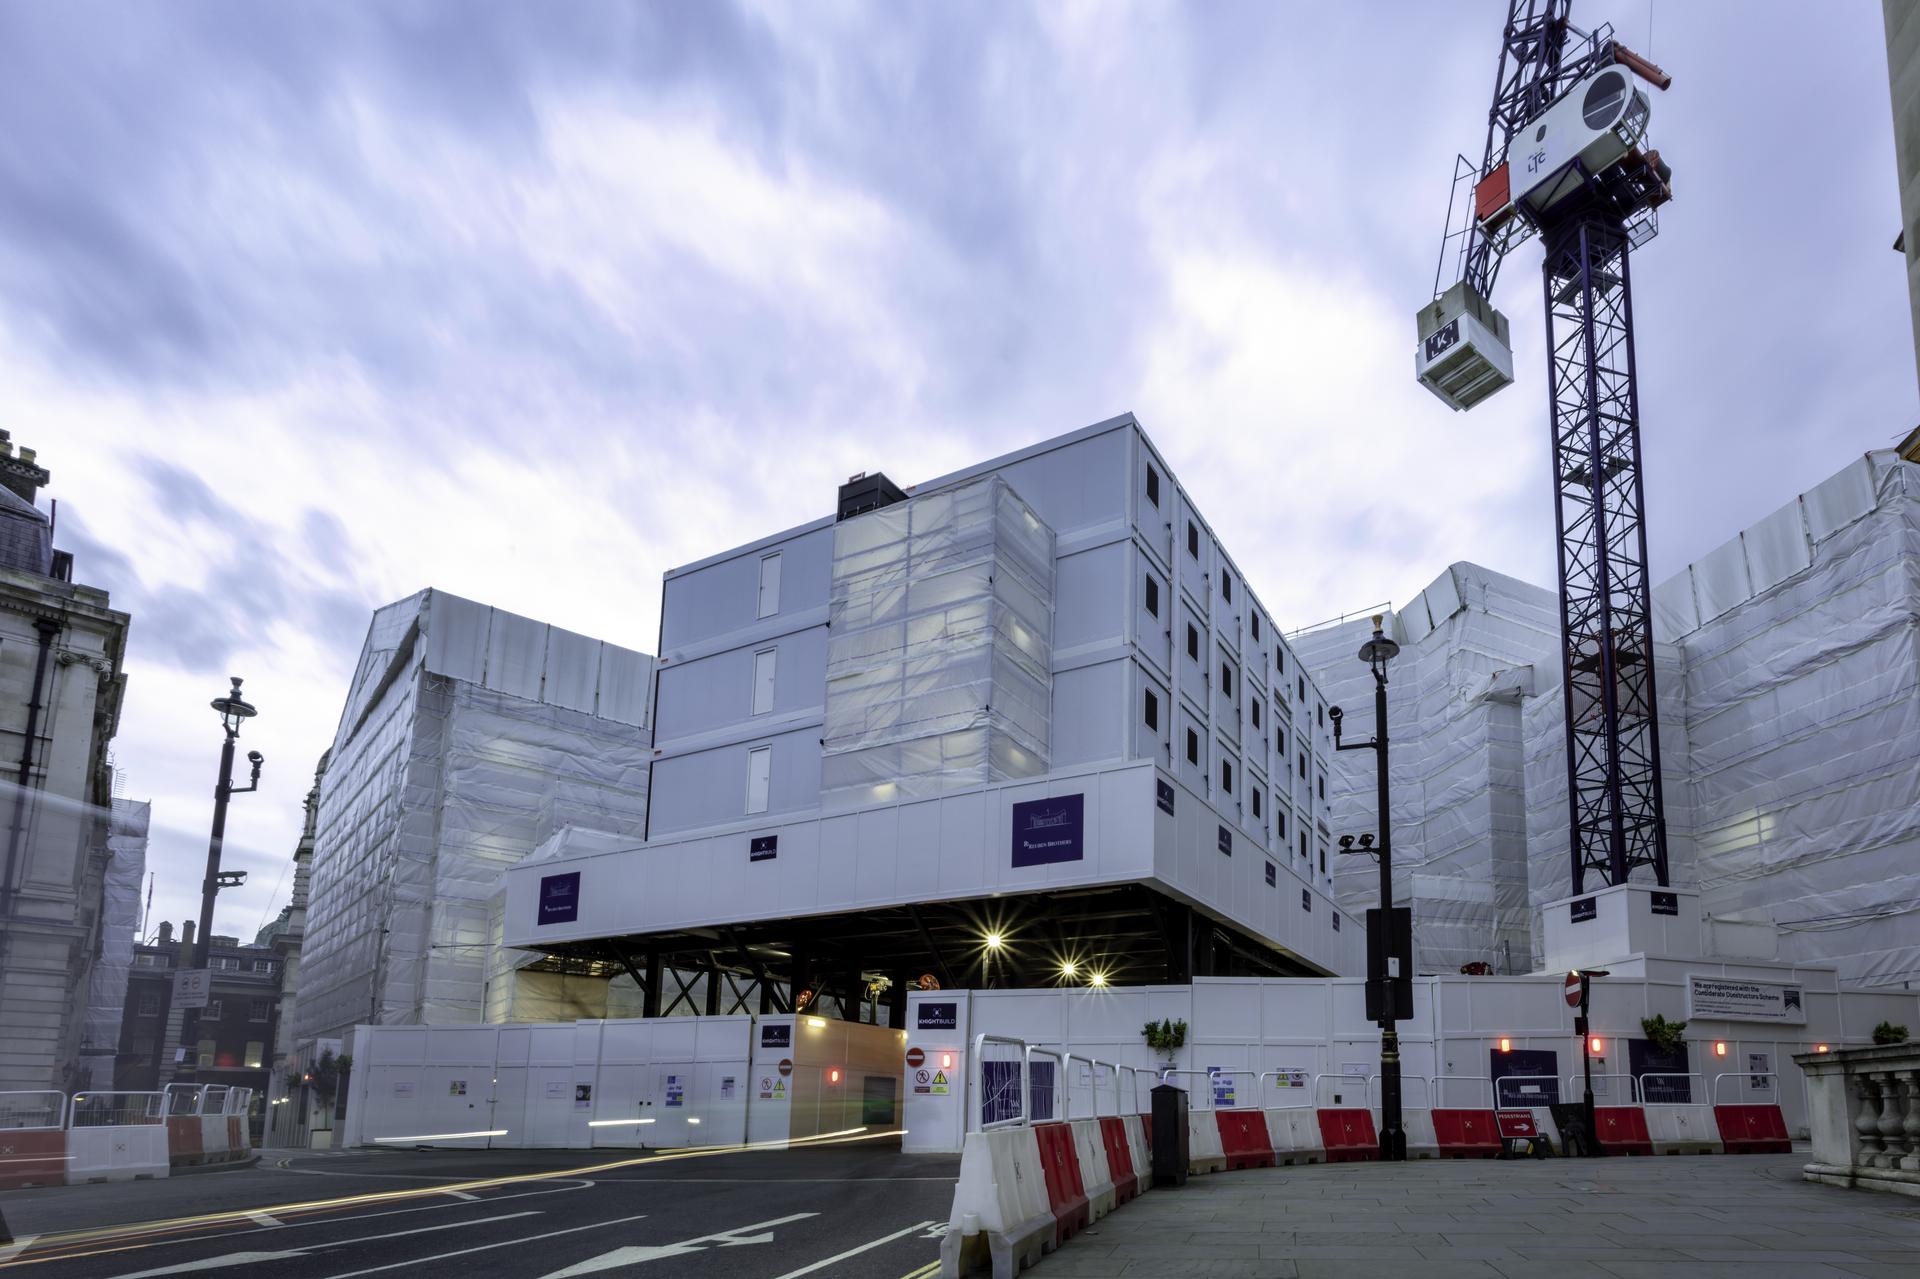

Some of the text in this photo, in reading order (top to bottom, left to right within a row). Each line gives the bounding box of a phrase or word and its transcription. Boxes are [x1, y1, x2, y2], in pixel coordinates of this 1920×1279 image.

[1528, 151, 1546, 173] LTC
[1711, 983, 1738, 991] registered
[1694, 989, 1726, 998] Considerate
[1726, 991, 1759, 1000] Constructors
